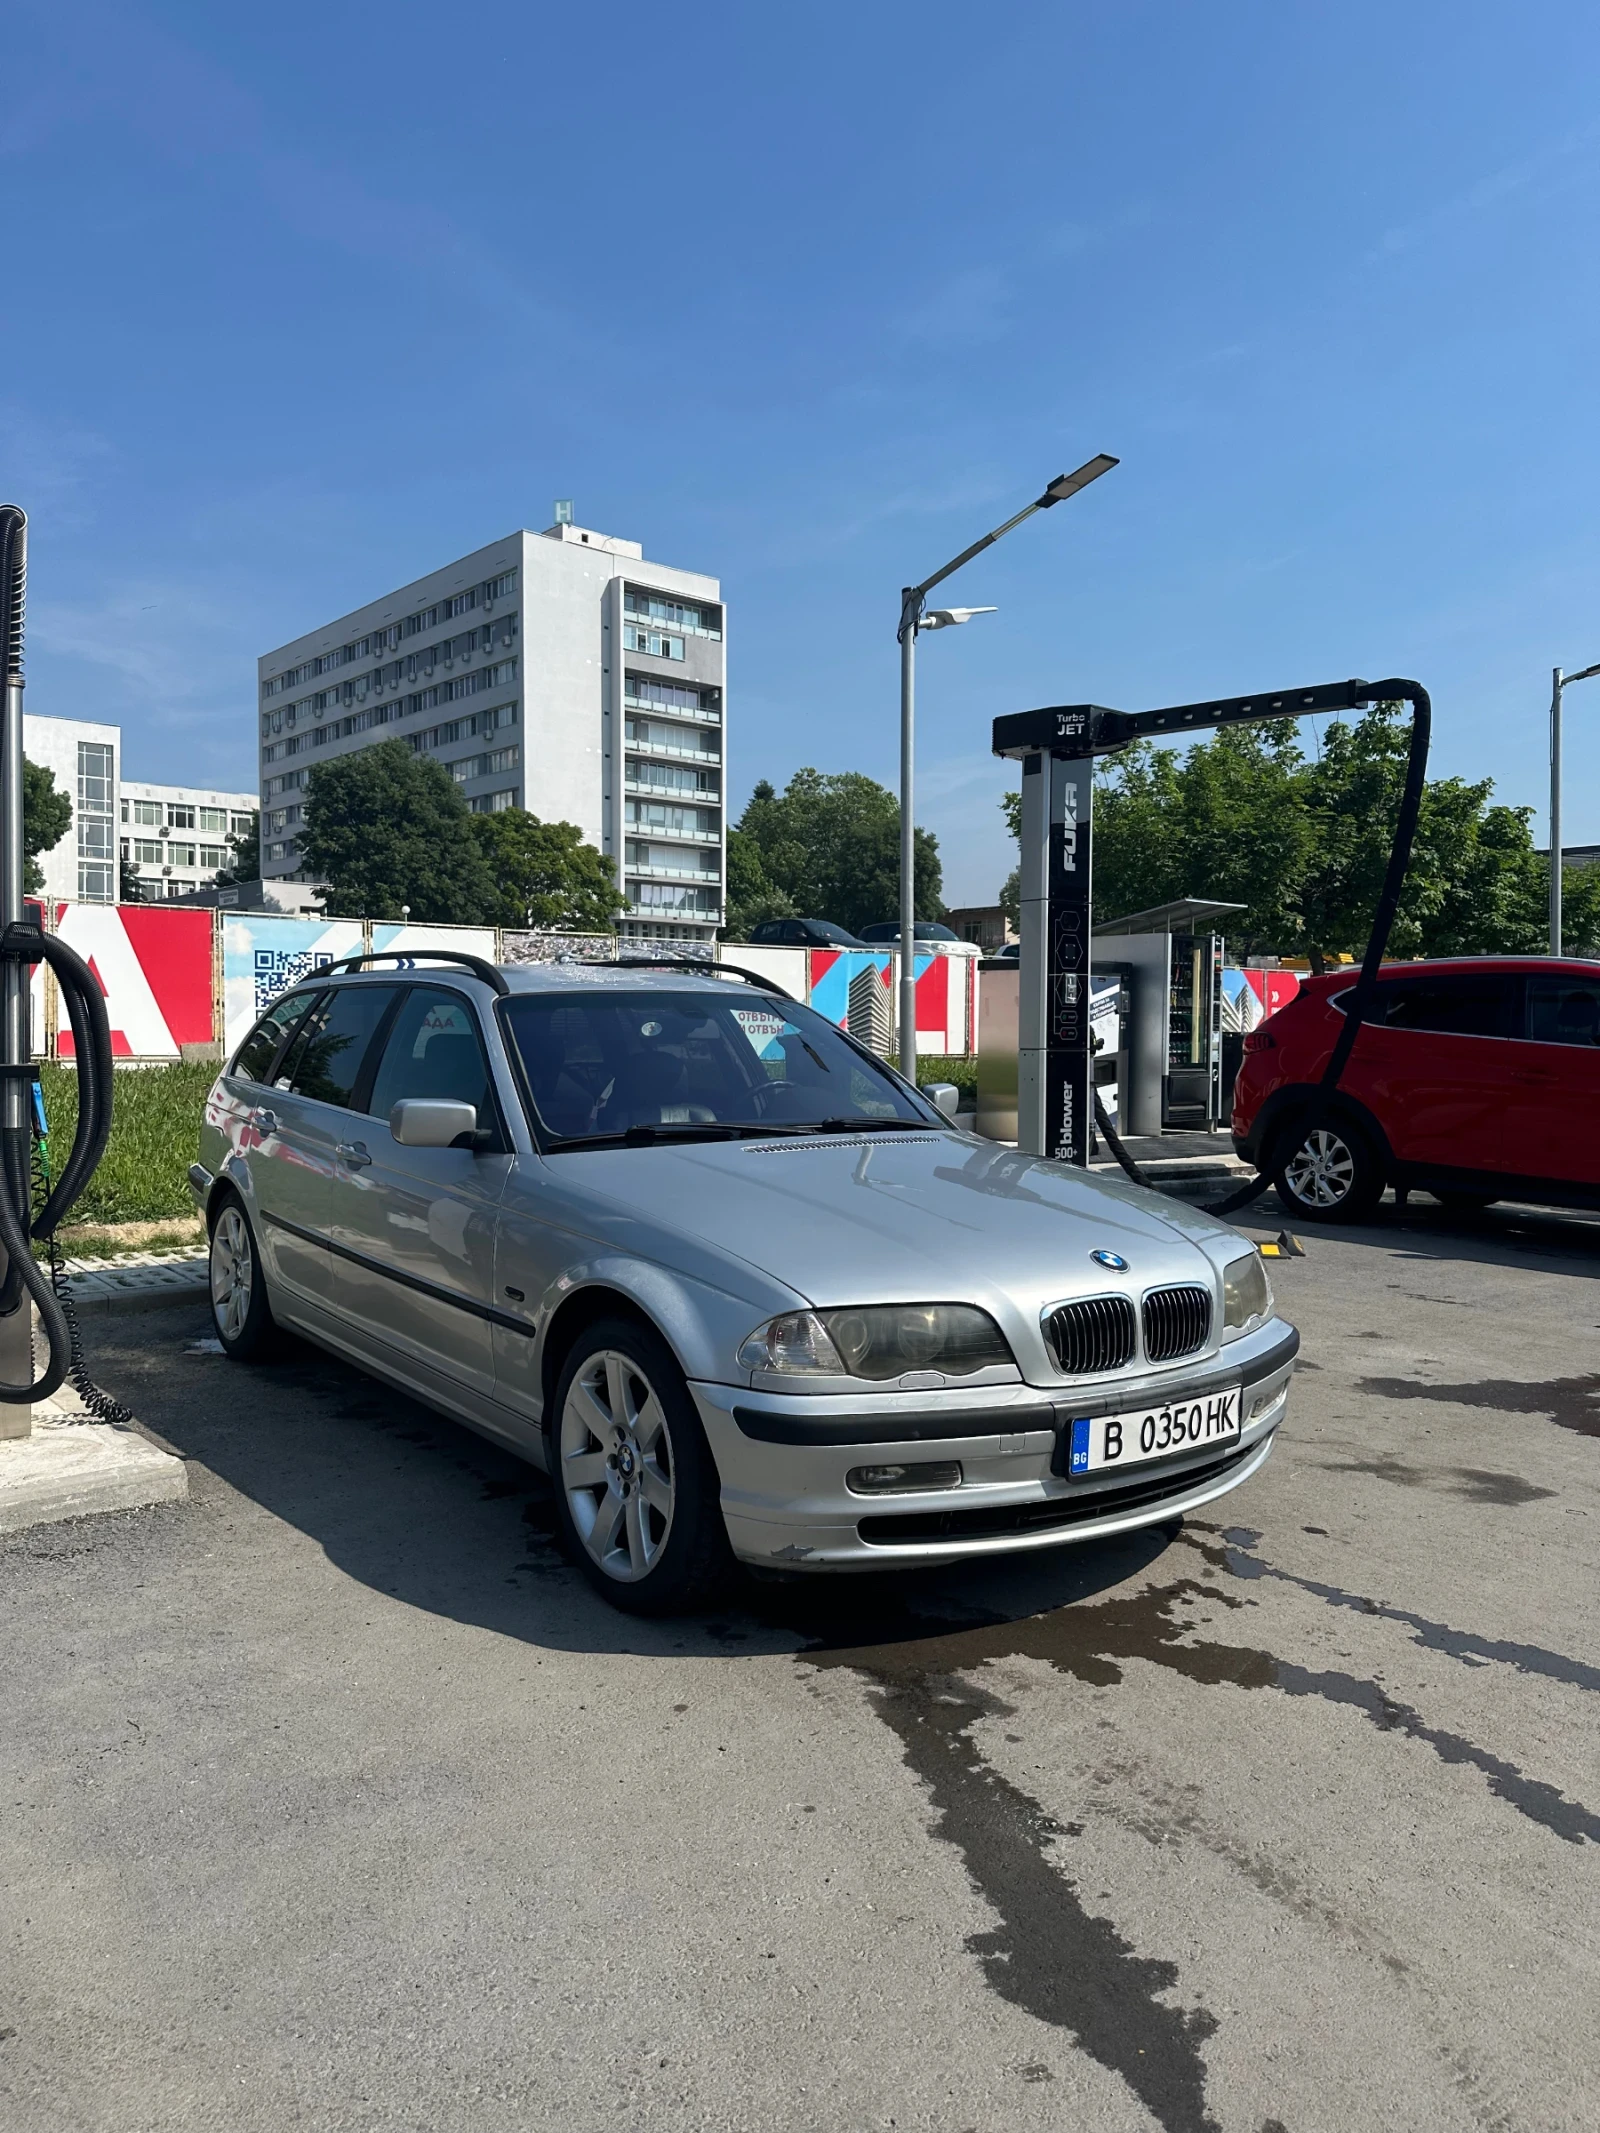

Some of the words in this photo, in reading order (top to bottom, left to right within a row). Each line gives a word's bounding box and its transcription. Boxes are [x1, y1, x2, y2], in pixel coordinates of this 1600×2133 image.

[1057, 714, 1085, 723] Turbo
[1057, 723, 1085, 735] JET
[1064, 782, 1077, 872] FUKA
[1060, 1081, 1073, 1144] blower
[1054, 1147, 1078, 1159] 500+
[1104, 1421, 1123, 1461] B
[1073, 1452, 1087, 1466] BG
